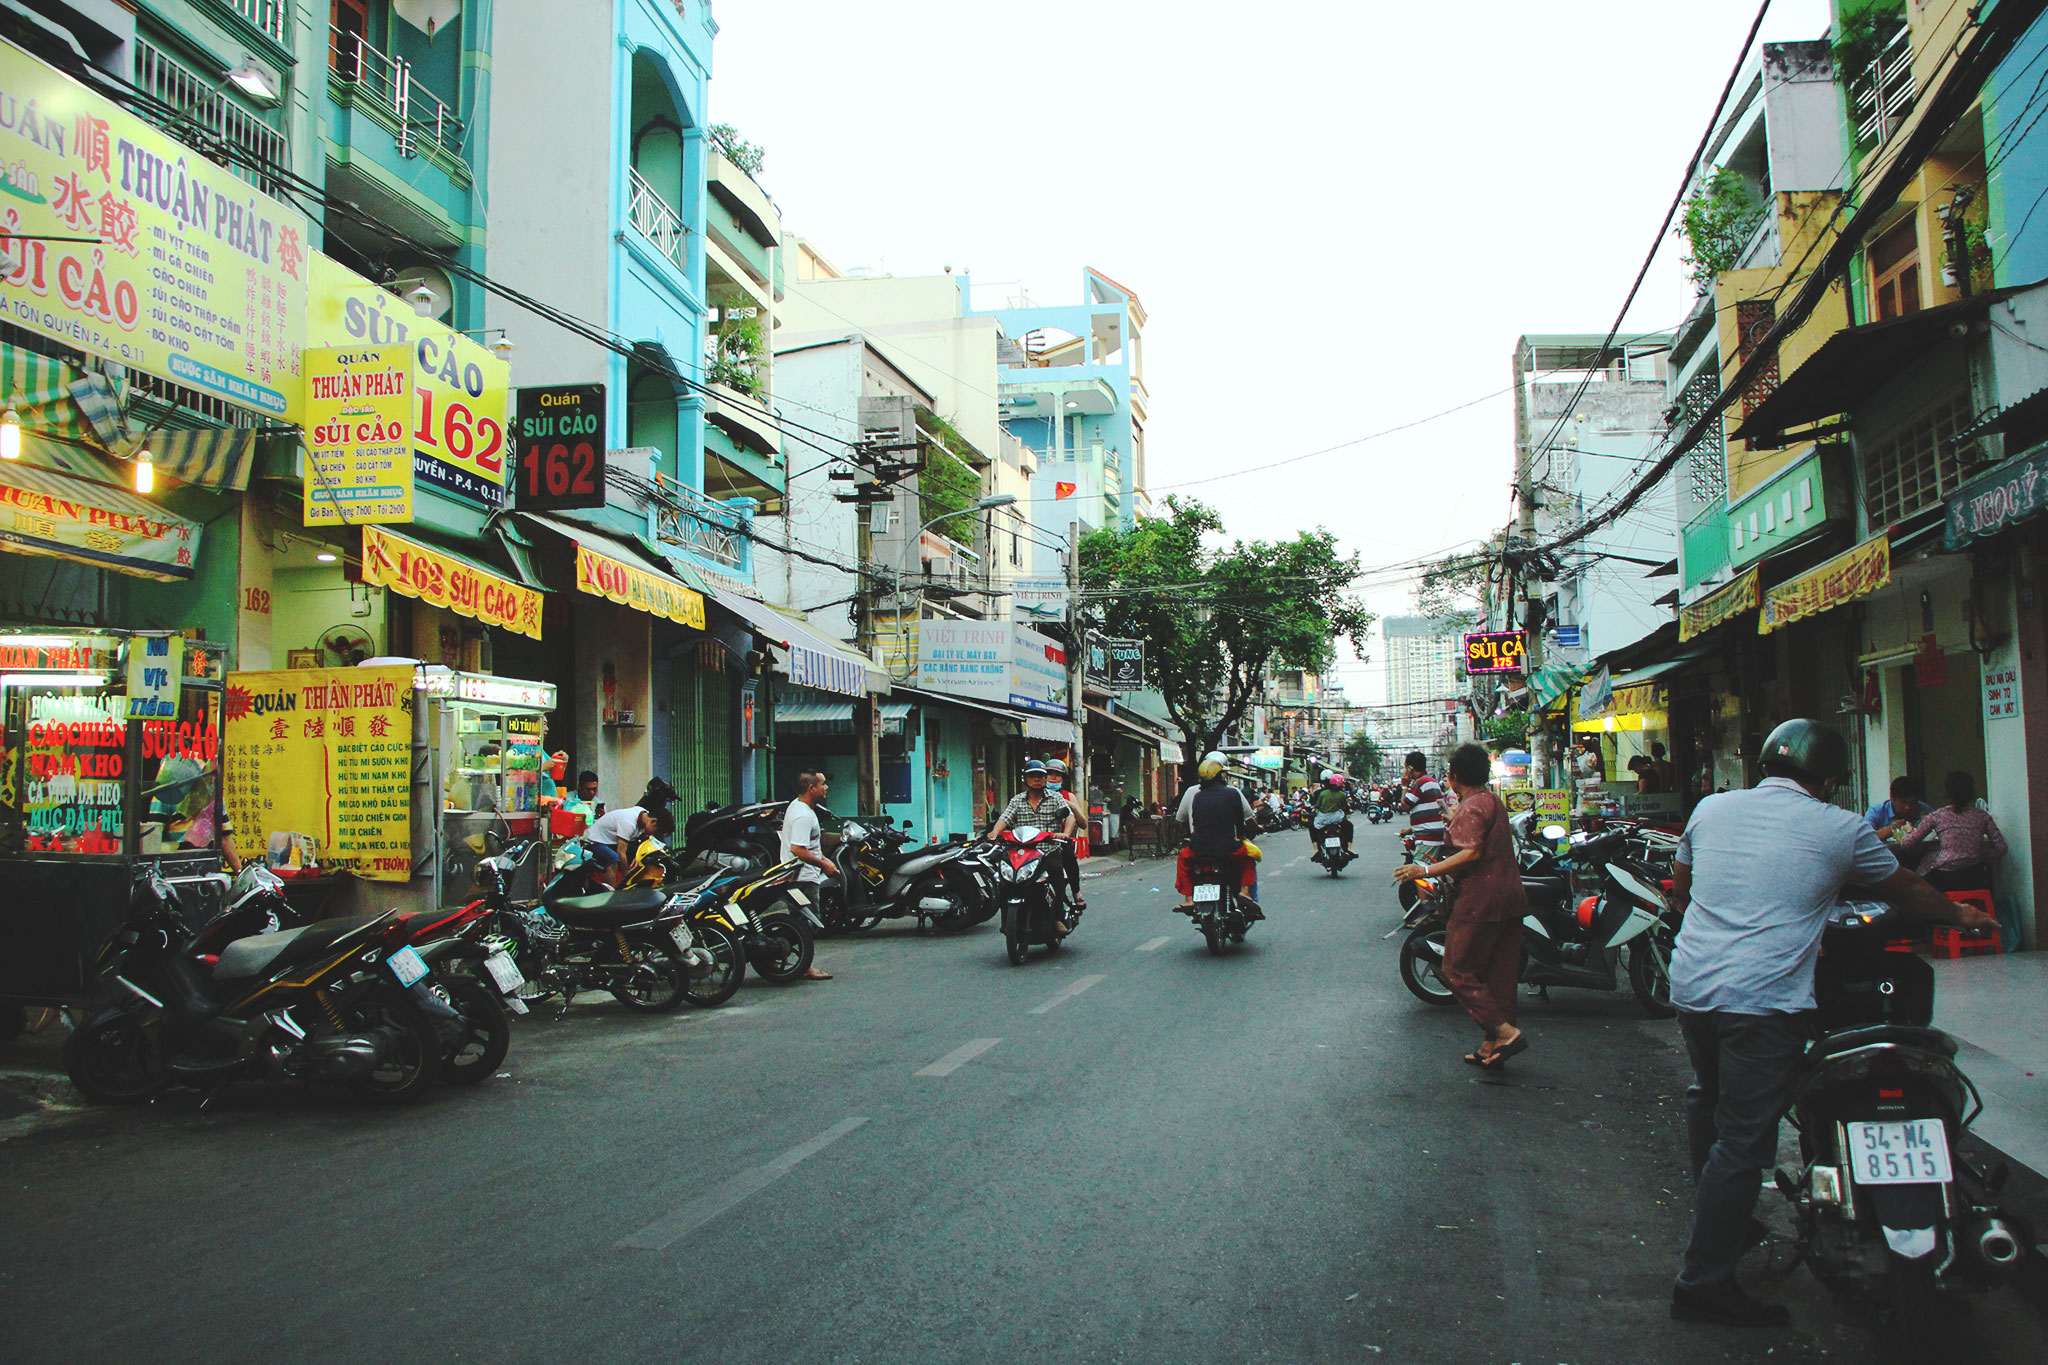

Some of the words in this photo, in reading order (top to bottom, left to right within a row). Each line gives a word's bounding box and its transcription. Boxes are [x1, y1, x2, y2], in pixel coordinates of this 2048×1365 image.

[73, 112, 111, 184] 順
[118, 138, 209, 233] THUẬN
[215, 193, 273, 265] PHÁT
[277, 225, 303, 281] 發
[58, 249, 138, 325] CẢO
[14, 300, 39, 324] TÔN
[337, 351, 380, 366] QUÁN
[417, 334, 484, 399] CẢO
[312, 368, 362, 403] THUẬN
[366, 365, 404, 396] PHÁT
[540, 391, 580, 406] Quán
[313, 416, 351, 445] SỦI
[357, 414, 404, 443] CẢO
[414, 386, 503, 475] 162
[523, 409, 553, 438] SỦI
[559, 407, 597, 436] CẢO
[455, 473, 472, 492] P.4
[523, 442, 595, 496] 162
[1970, 479, 2019, 533] NGỌC
[88, 507, 171, 540] PHÁT
[396, 551, 445, 597] 162
[581, 554, 628, 597] 160
[244, 587, 270, 614] 162
[926, 627, 959, 645] VIỆT
[962, 628, 1005, 645] TRINH
[1469, 637, 1498, 659] SỦI
[46, 641, 92, 669] PHÁT
[983, 650, 997, 661] BAY
[1112, 649, 1142, 660] YUNE
[1492, 656, 1514, 668] 175
[144, 668, 168, 690] Vịt
[354, 677, 395, 708] PHÁT
[465, 678, 486, 698] 162
[937, 676, 967, 686] Vietnam
[967, 678, 994, 687] Airlines
[253, 687, 297, 716] QUÁN
[79, 753, 123, 777] KHO
[97, 782, 121, 805] HEO
[1862, 1124, 1931, 1150] 54-M4
[1867, 1151, 1936, 1179] 8515
